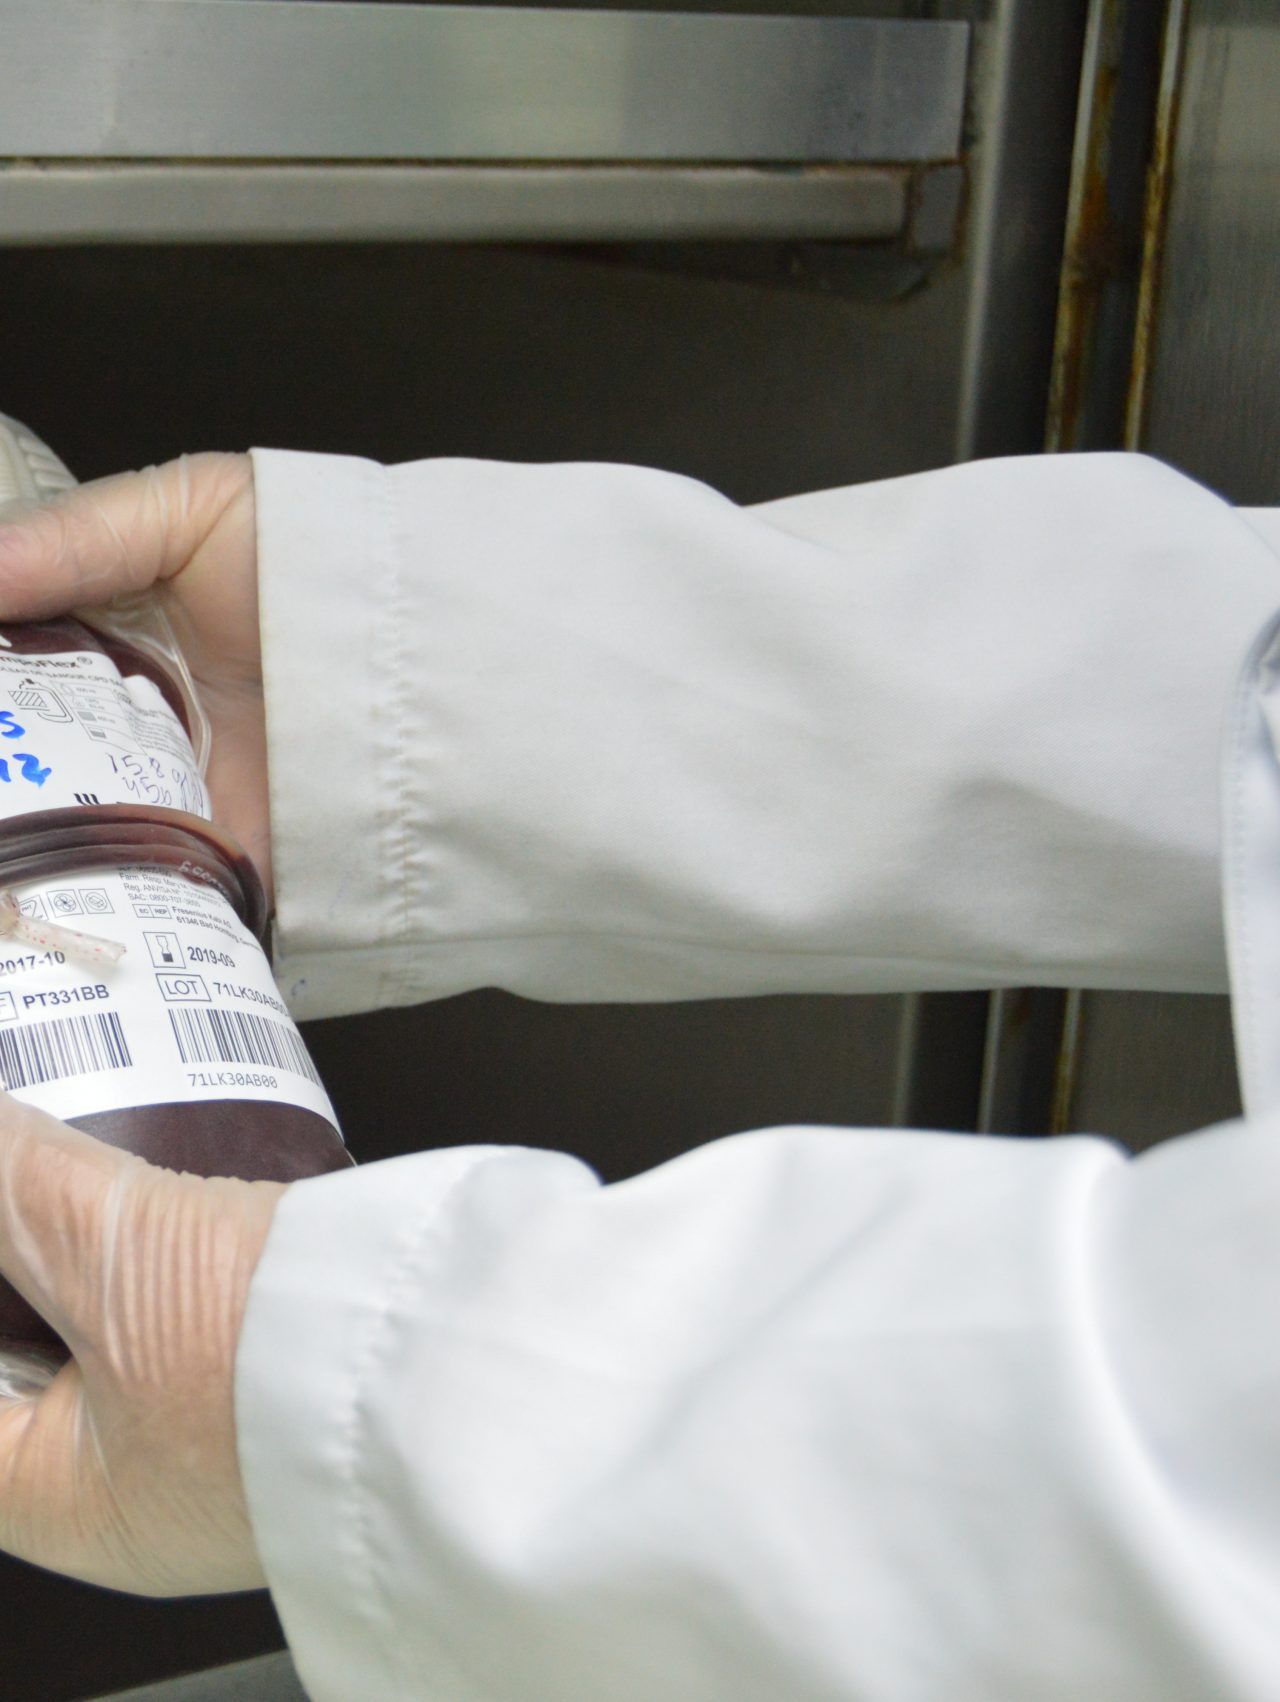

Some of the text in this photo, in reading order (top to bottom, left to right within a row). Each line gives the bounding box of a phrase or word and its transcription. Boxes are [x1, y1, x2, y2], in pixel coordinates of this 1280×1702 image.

[186, 945, 236, 969] 2019-09
[22, 983, 111, 1010] PT331BB
[164, 979, 198, 996] LOT
[187, 1071, 279, 1089] 71LK30AB00
